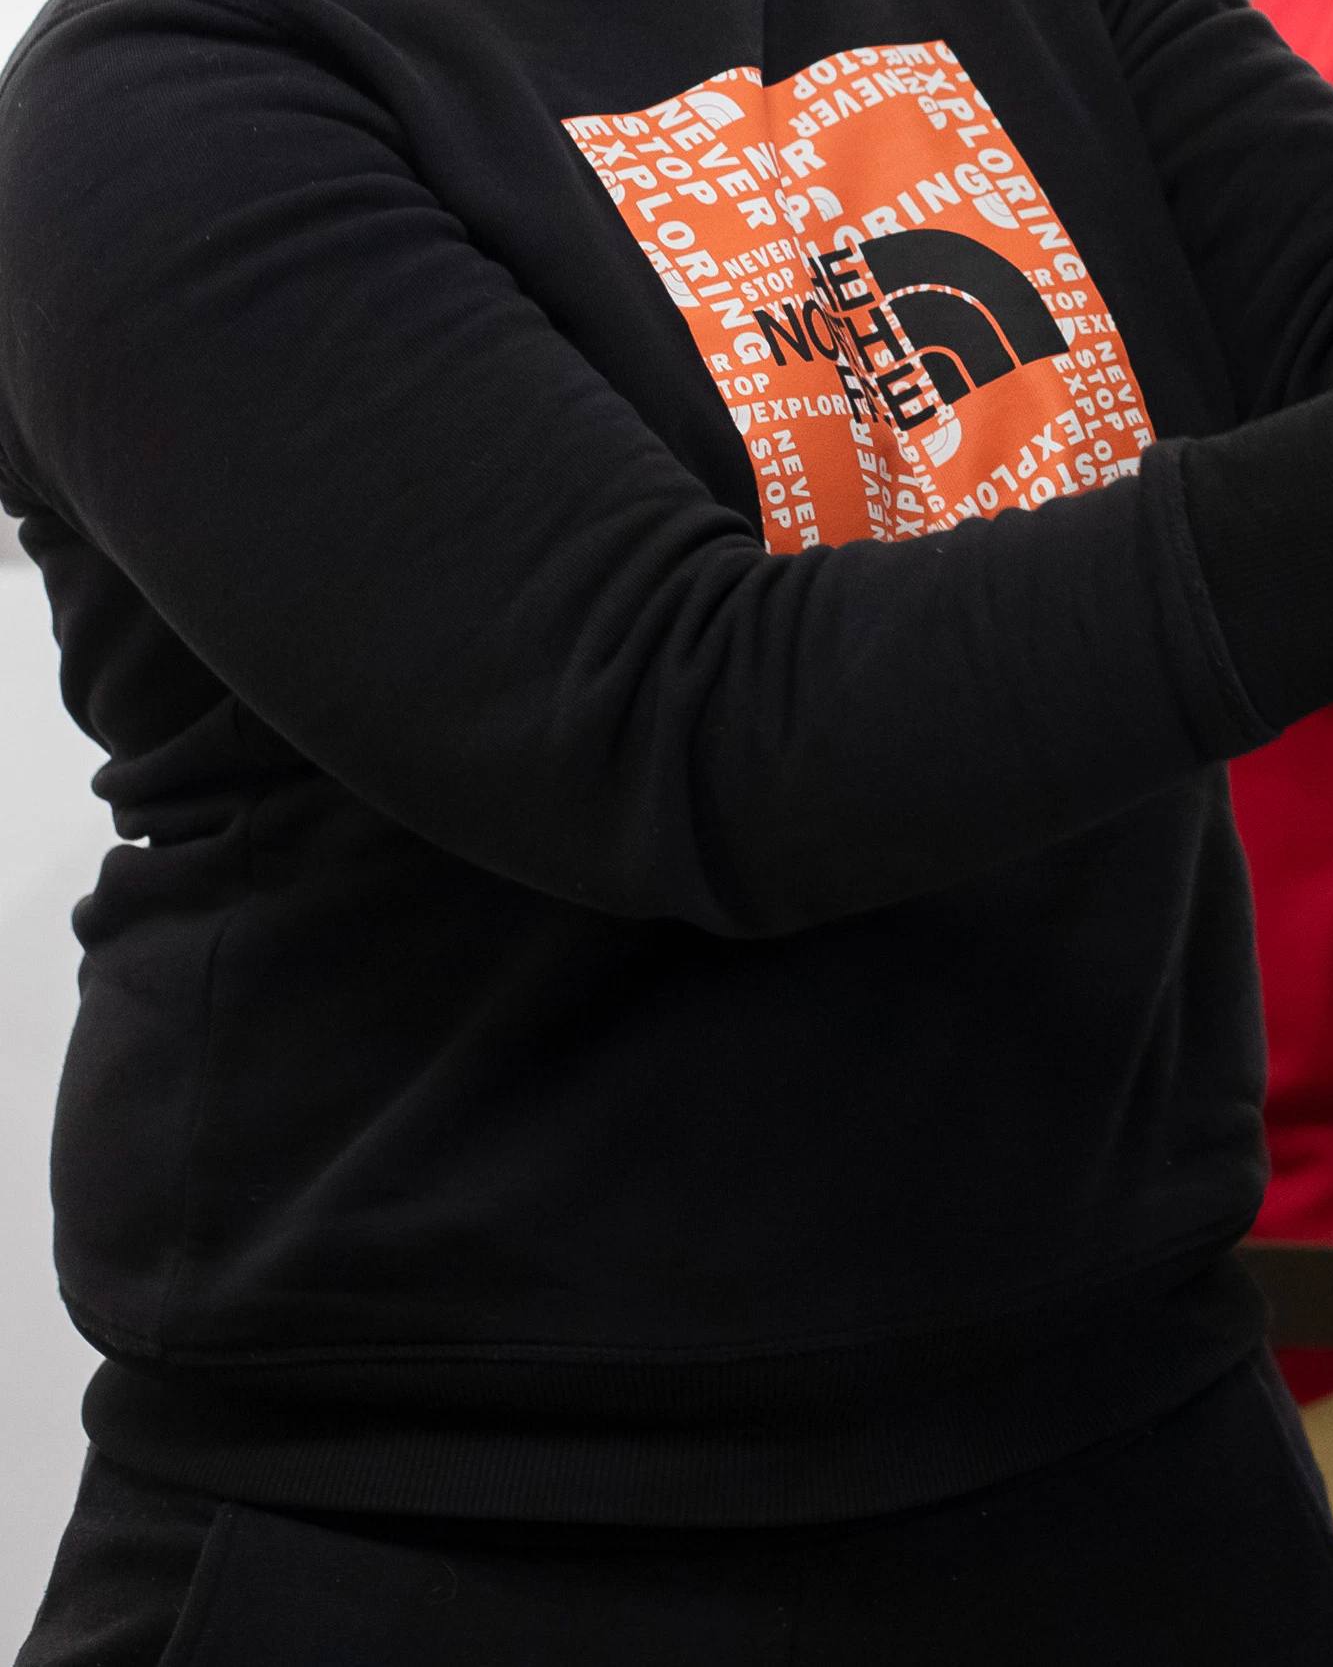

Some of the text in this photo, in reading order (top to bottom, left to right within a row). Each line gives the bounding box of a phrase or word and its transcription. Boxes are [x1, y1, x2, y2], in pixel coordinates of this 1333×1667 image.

[789, 69, 908, 137] NEVER
[612, 115, 718, 205] STOP
[646, 99, 777, 229] NEVER
[898, 45, 1086, 282] EXPLORING
[571, 117, 771, 365] EXPLORING
[722, 238, 796, 279] NEVER
[740, 267, 795, 302] STOP
[1075, 348, 1125, 431] STOP
[1095, 341, 1153, 450] NEVER
[751, 437, 792, 529] STOP
[772, 429, 820, 550] NEVER
